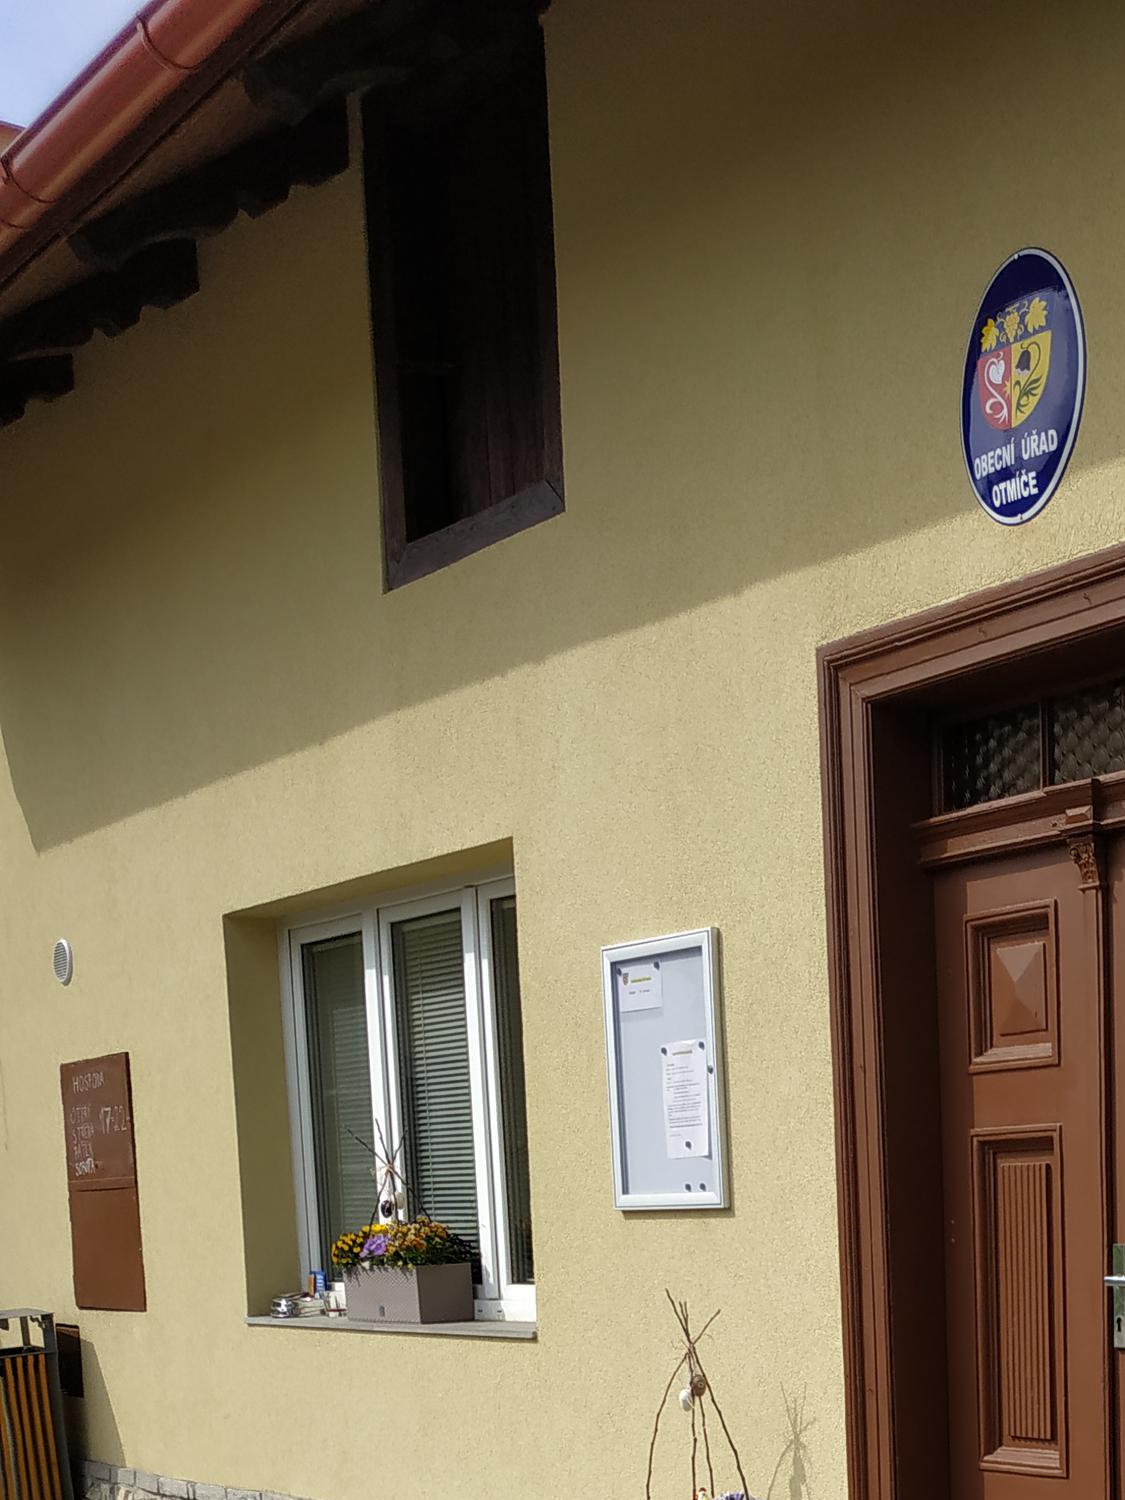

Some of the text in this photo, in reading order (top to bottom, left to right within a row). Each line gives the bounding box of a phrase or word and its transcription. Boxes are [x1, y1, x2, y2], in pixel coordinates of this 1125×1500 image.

[974, 429, 1058, 480] OBECNÍ ÚŘAD
[992, 469, 1039, 507] OTMÍČE
